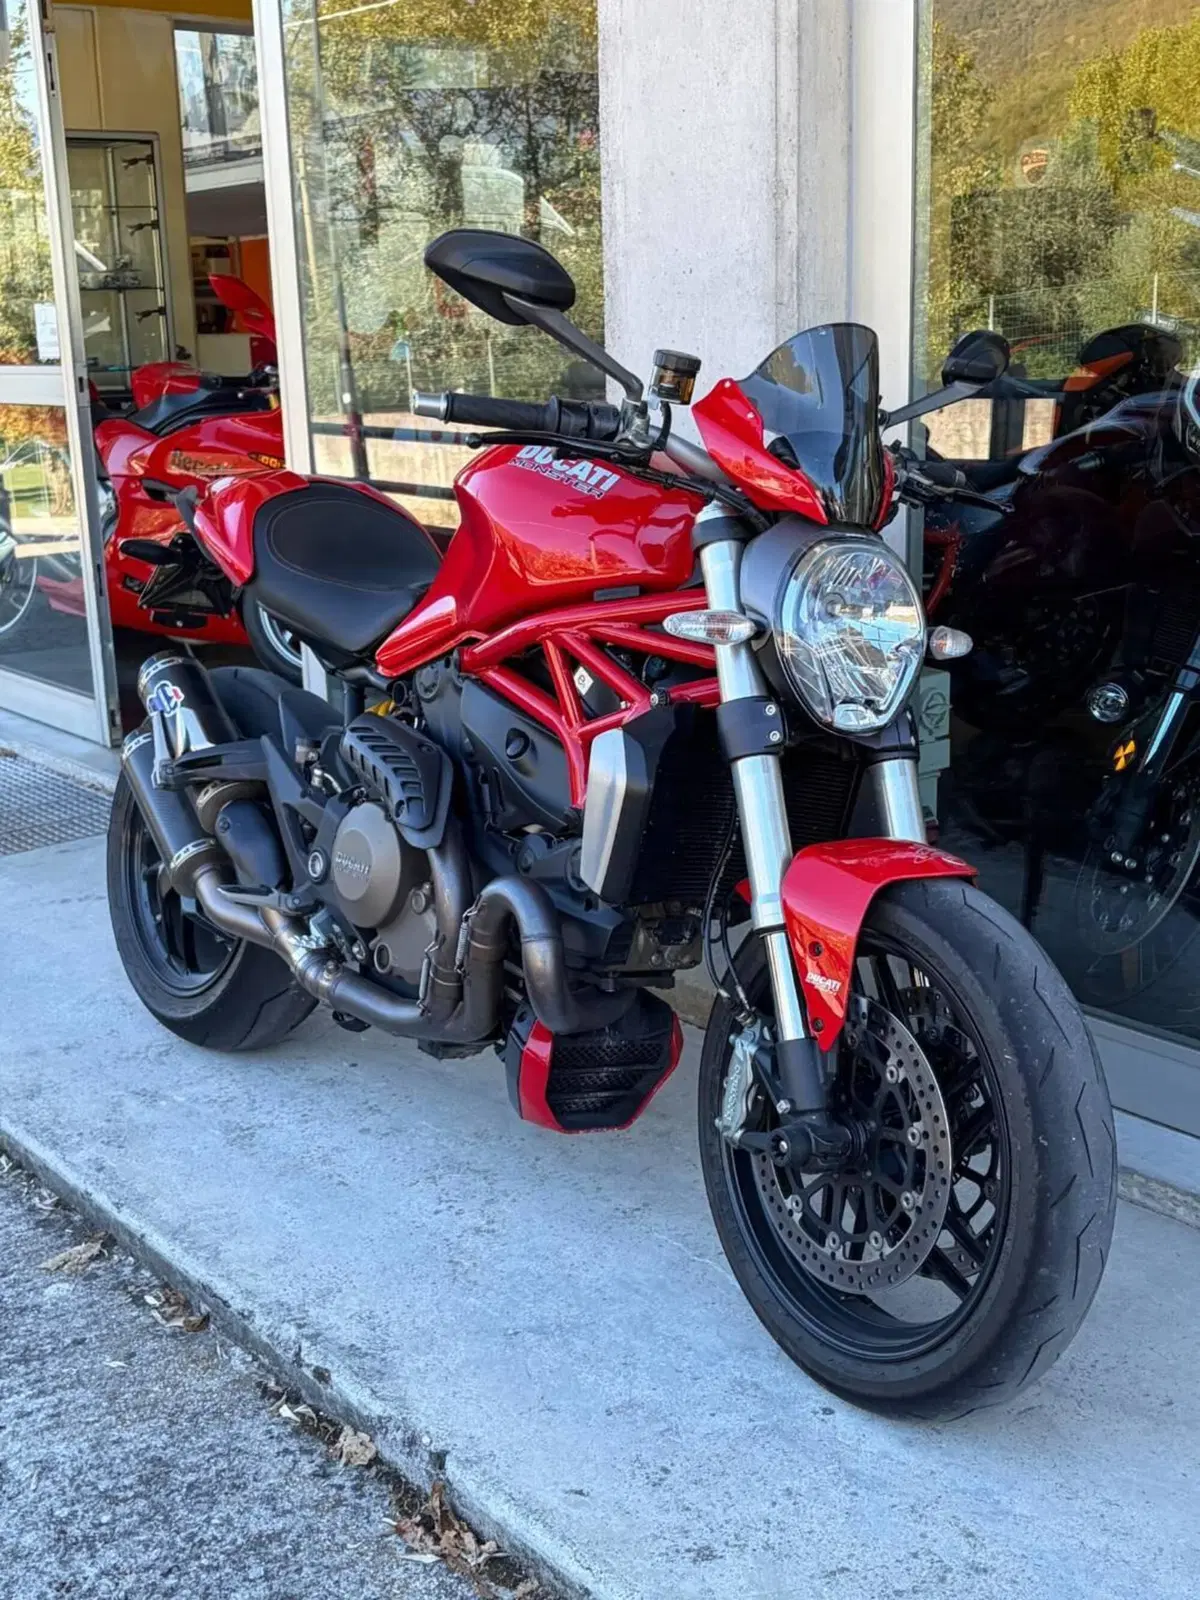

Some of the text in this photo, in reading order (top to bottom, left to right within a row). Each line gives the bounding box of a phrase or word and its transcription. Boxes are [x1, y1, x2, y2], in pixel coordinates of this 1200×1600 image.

[508, 457, 605, 499] MONSTER
[516, 444, 621, 492] DUCATI
[806, 972, 841, 992] DUCATI
